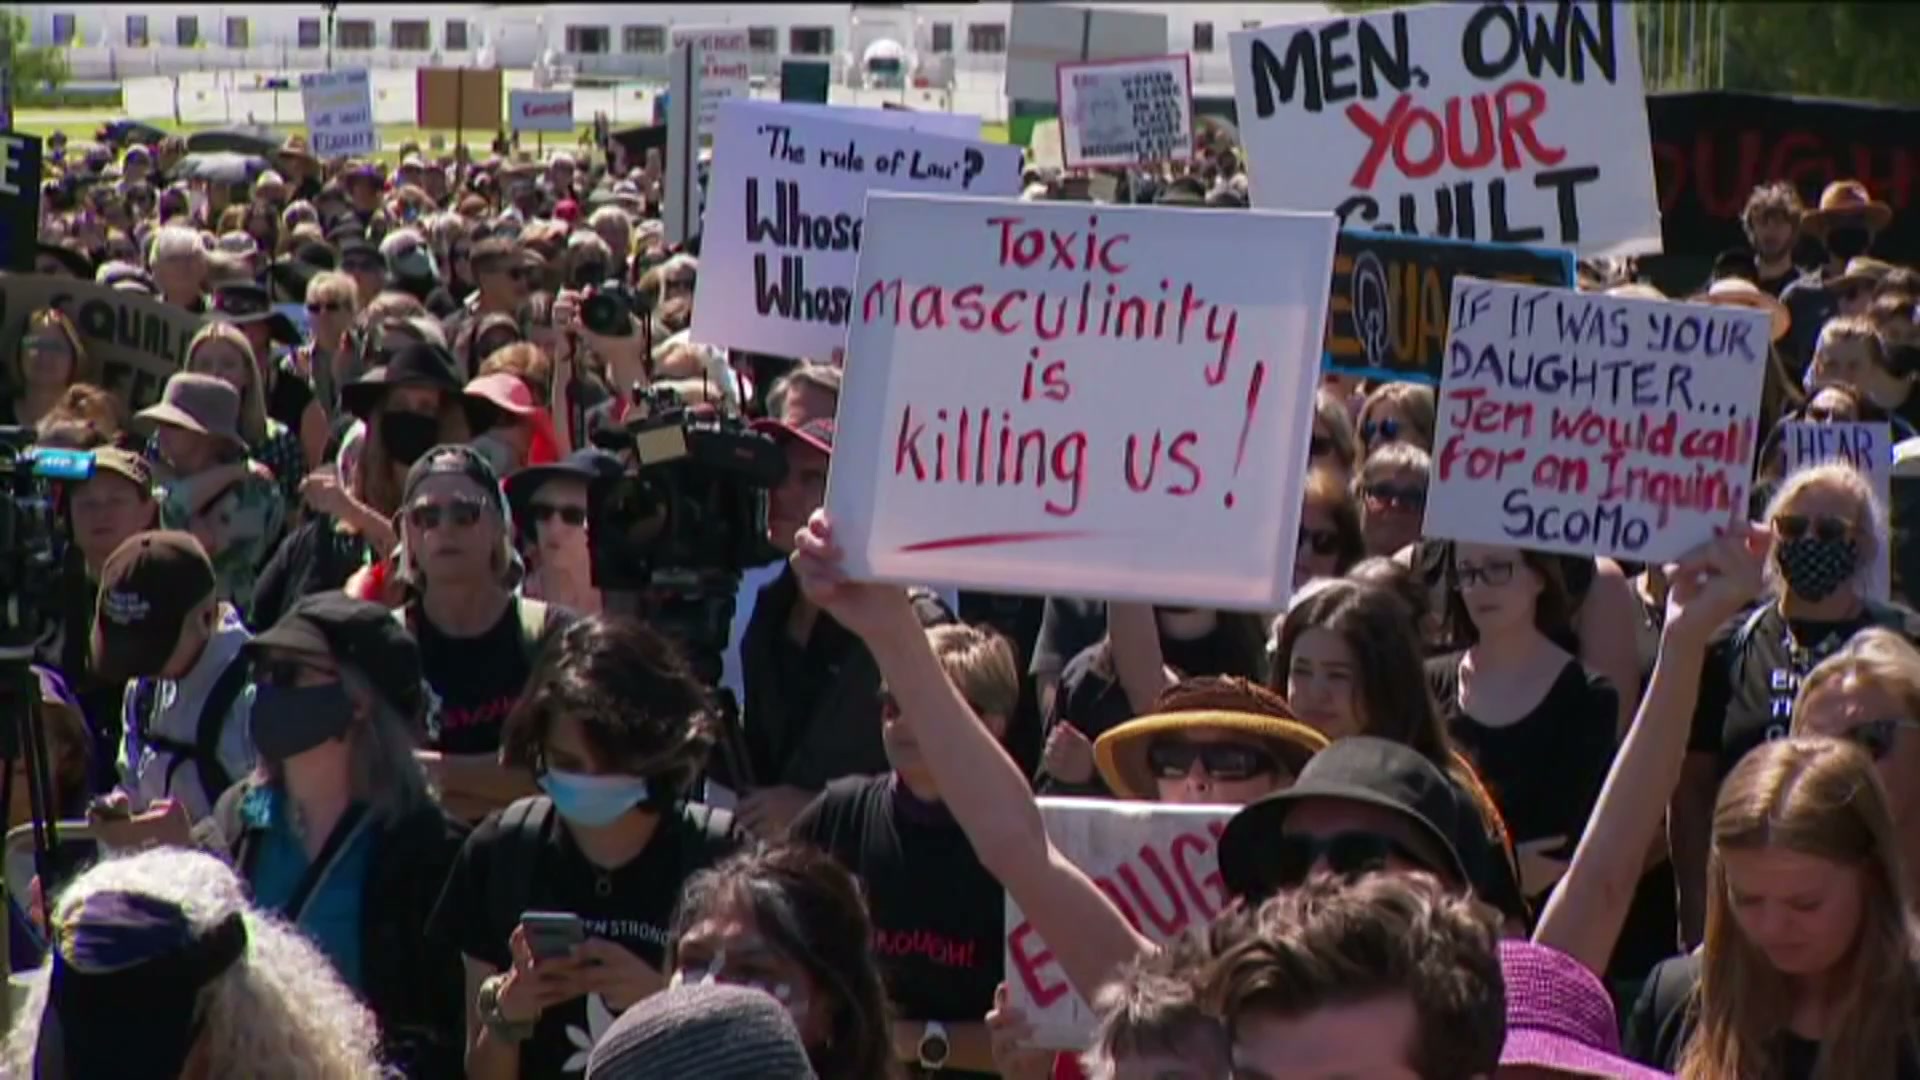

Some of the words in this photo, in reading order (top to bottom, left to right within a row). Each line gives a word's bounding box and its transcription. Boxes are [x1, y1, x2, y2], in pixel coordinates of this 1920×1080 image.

[1251, 11, 1430, 118] MEN,
[1462, 3, 1616, 84] OWN
[820, 140, 865, 171] rule
[875, 151, 904, 175] of
[1345, 82, 1567, 190] YOUR
[986, 215, 1131, 275] Toxic
[1453, 289, 1492, 333] IF
[1511, 291, 1551, 339] IT
[1556, 299, 1630, 347] WAS
[1647, 312, 1755, 361] YOUR
[1020, 345, 1072, 402] is
[895, 403, 1090, 516] killing
[1449, 391, 1535, 438] Jen
[1551, 406, 1678, 456] would
[1680, 414, 1755, 465] call
[1796, 424, 1873, 472] HEAR
[1438, 434, 1527, 483] for
[1531, 451, 1590, 494] an
[1502, 487, 1650, 551] ScoMo
